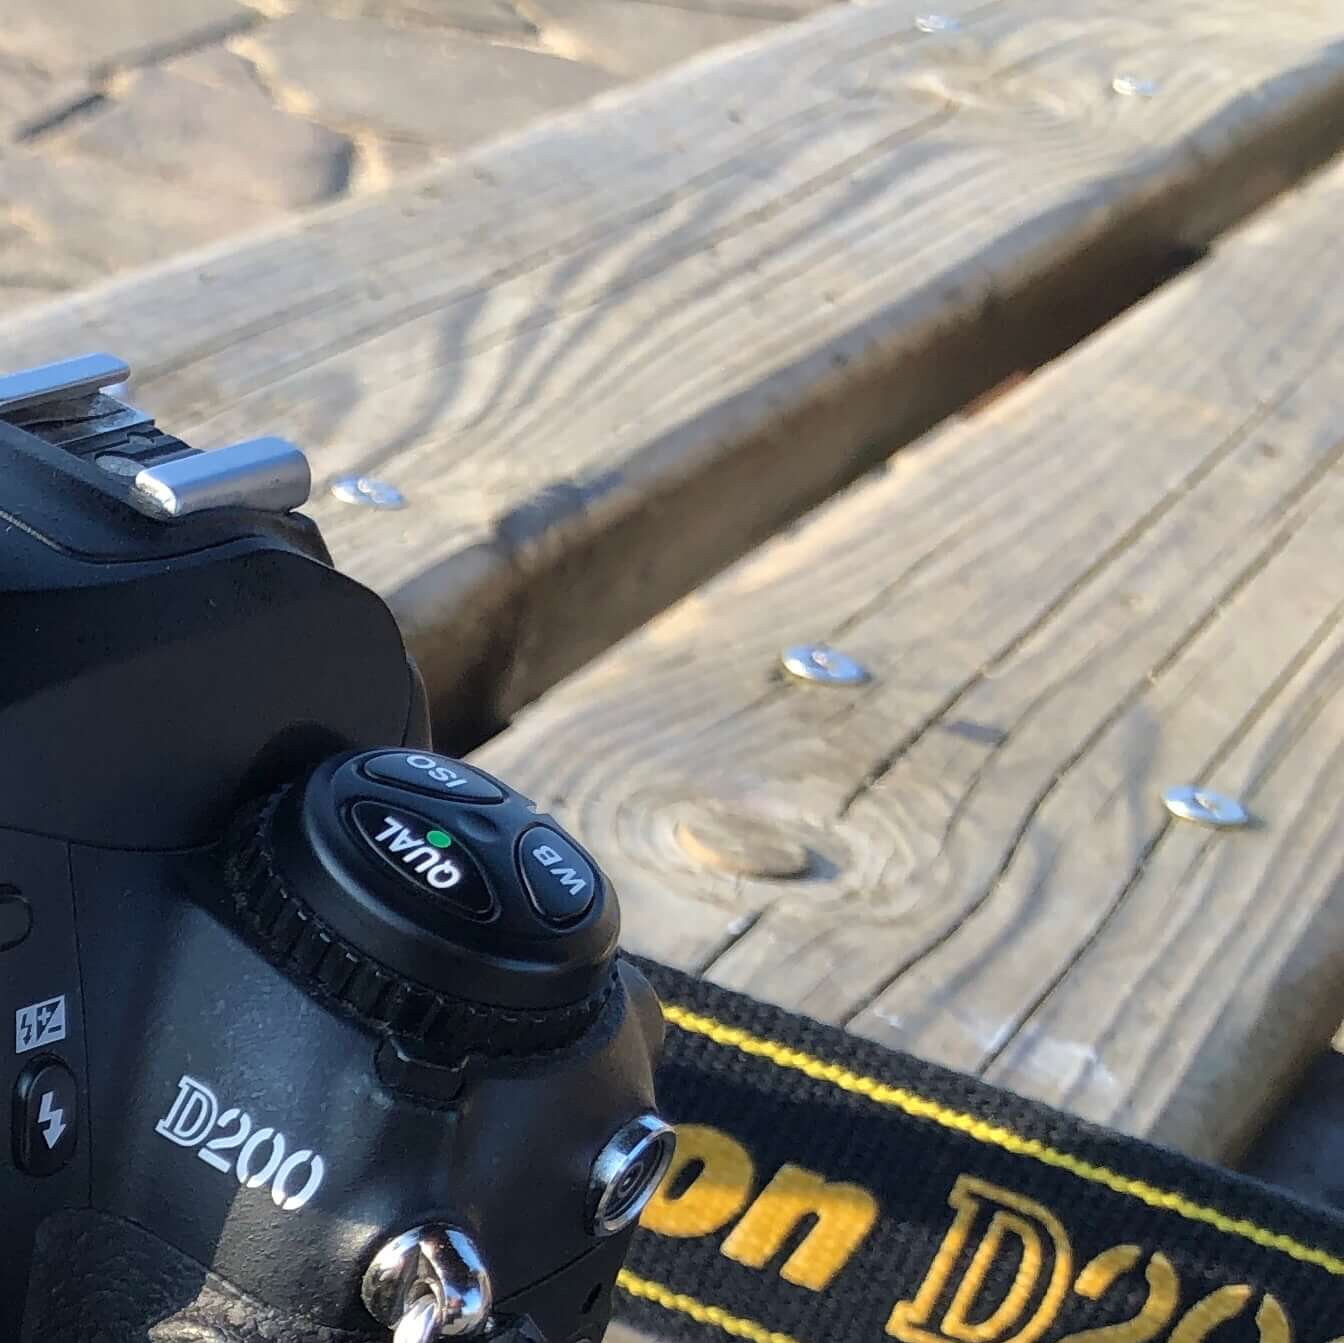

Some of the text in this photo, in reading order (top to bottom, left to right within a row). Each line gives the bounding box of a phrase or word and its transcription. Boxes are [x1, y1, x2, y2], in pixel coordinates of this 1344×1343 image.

[407, 755, 468, 788] ISO
[375, 815, 461, 889] QUAL
[532, 845, 587, 896] WB
[154, 1075, 324, 1210] D200
[638, 1122, 879, 1292] on
